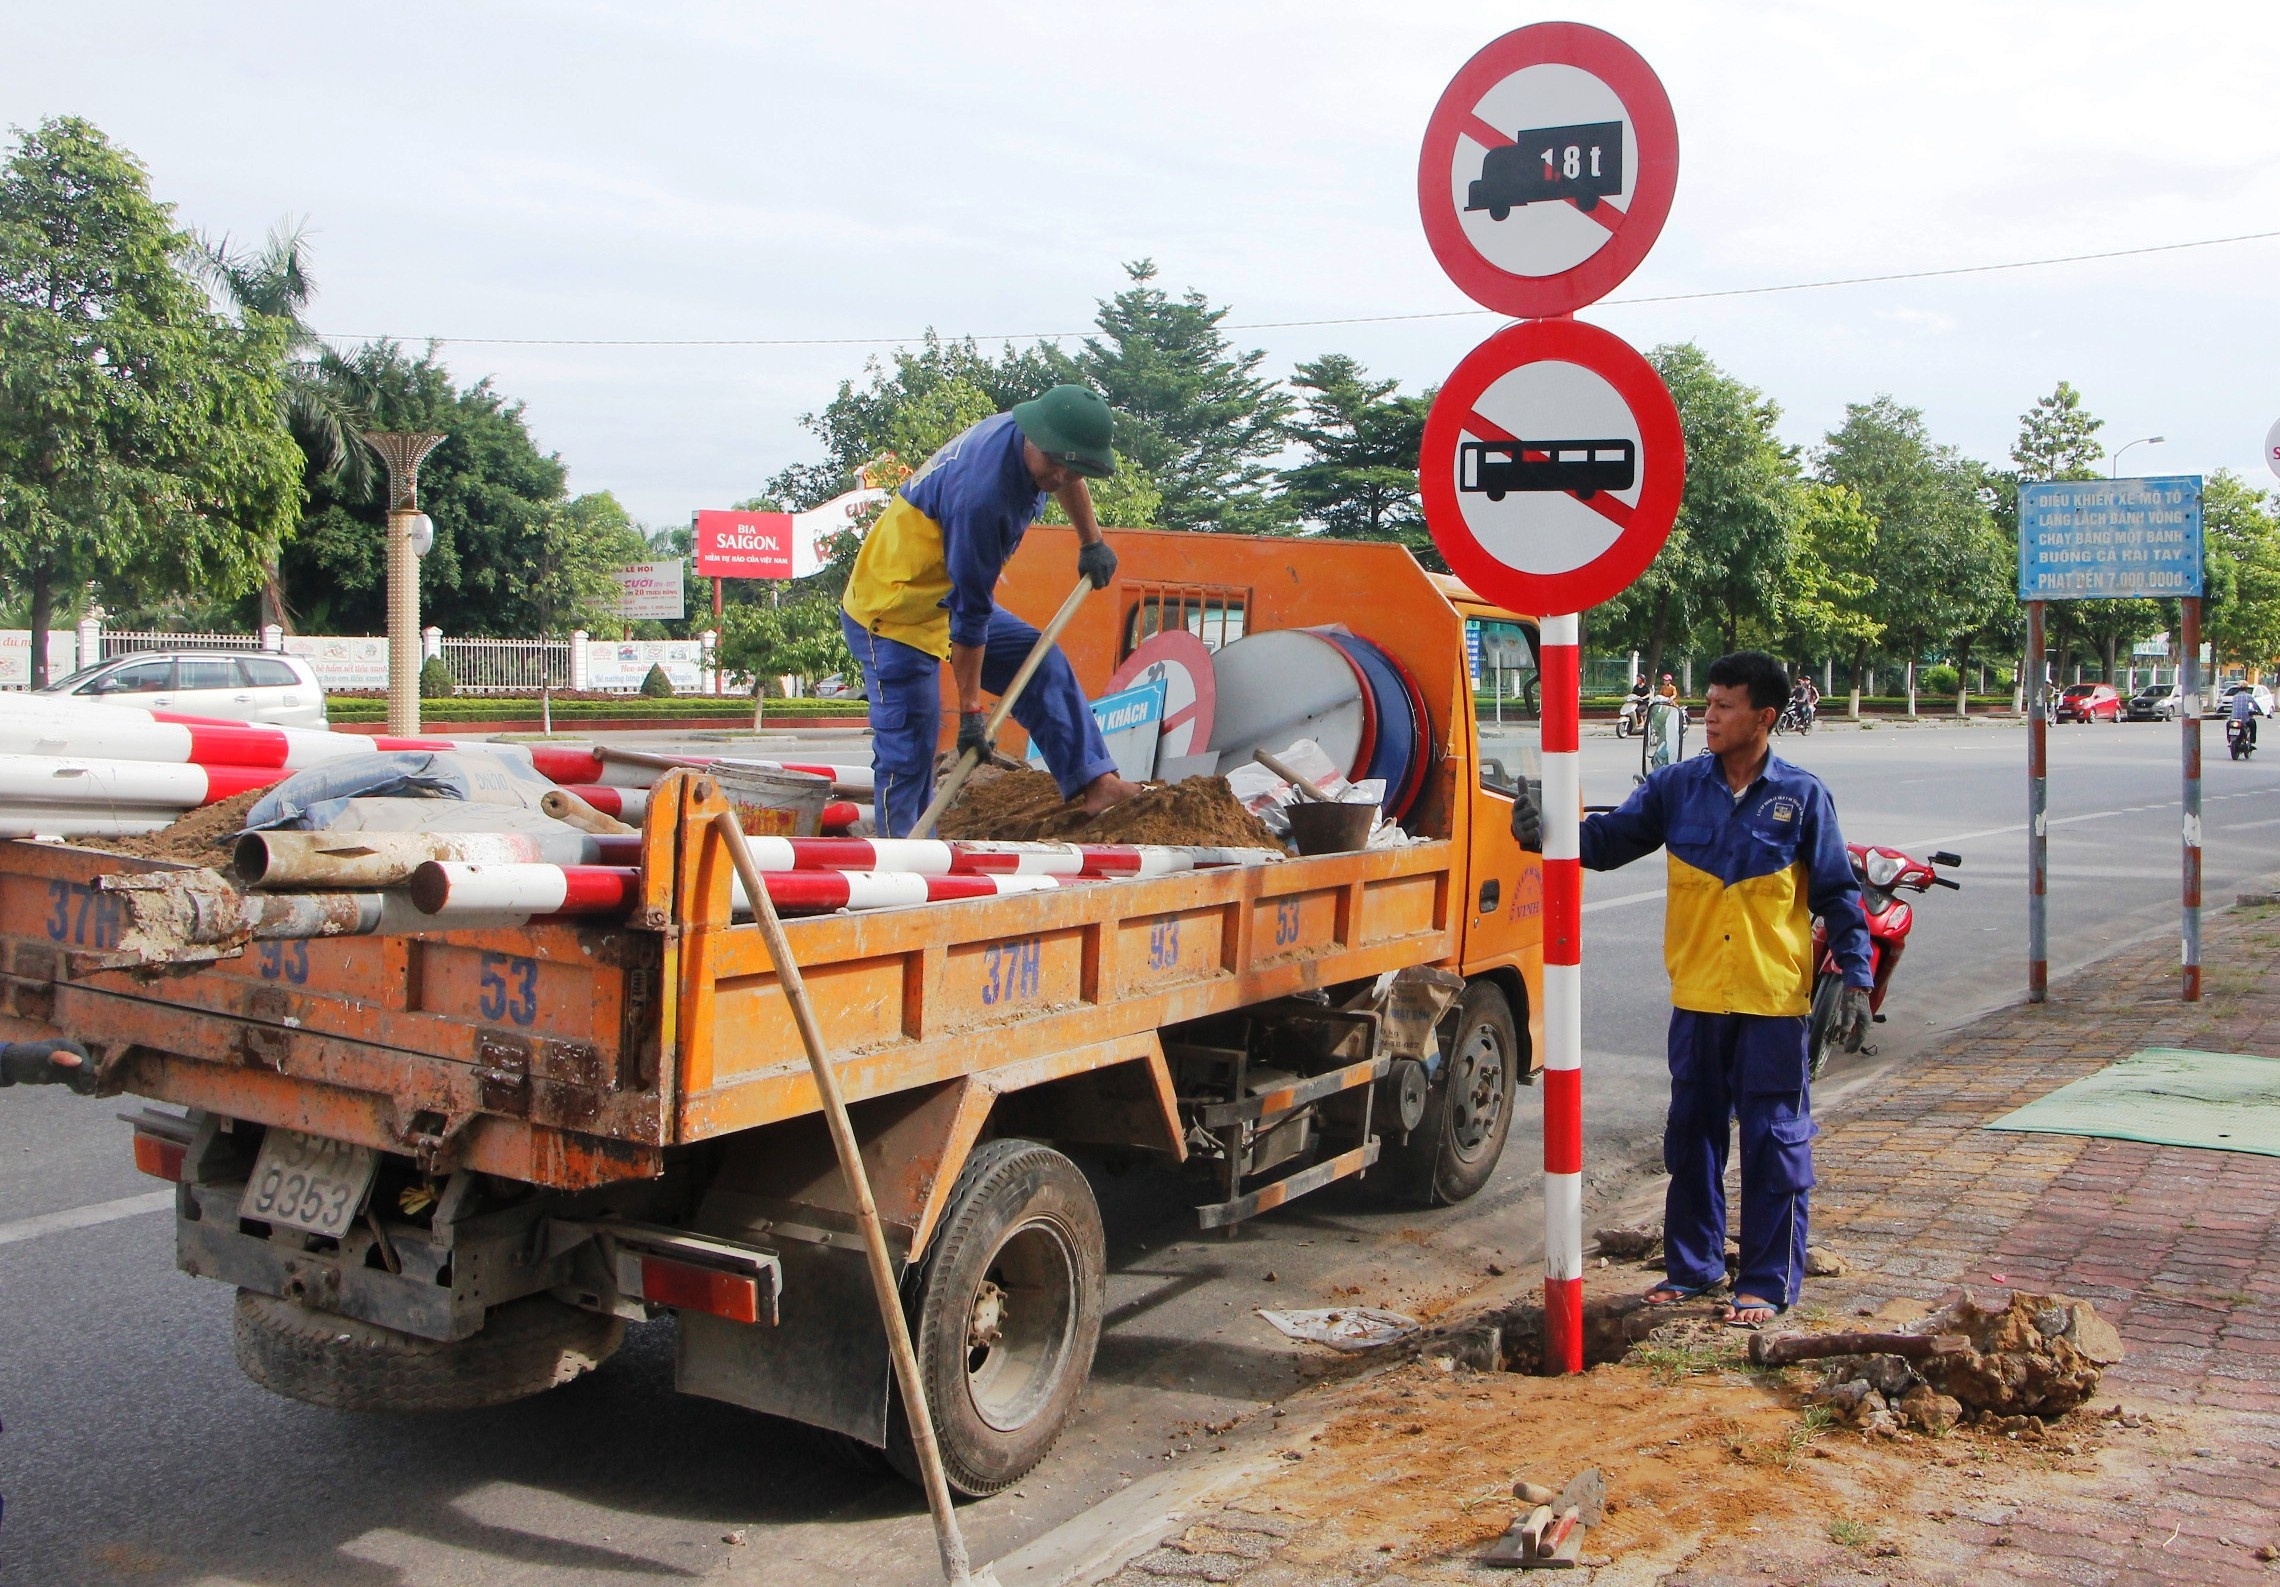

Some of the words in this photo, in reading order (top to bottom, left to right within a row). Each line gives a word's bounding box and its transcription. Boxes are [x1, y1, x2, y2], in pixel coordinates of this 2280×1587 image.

[1590, 146, 1601, 177] t
[2119, 492, 2135, 505] XE
[2140, 490, 2161, 504] MÔ
[2165, 489, 2182, 504] TÔ
[737, 524, 756, 534] BIA
[2122, 549, 2148, 561] HAI
[2153, 549, 2182, 560] TAY
[1107, 702, 1148, 731] KHÁCH
[47, 883, 119, 949] 37H
[481, 951, 538, 1026] 53
[982, 937, 1041, 1005] 37H
[1150, 916, 1180, 970] 93
[1275, 899, 1300, 946] 53
[256, 1168, 351, 1228] 9353
